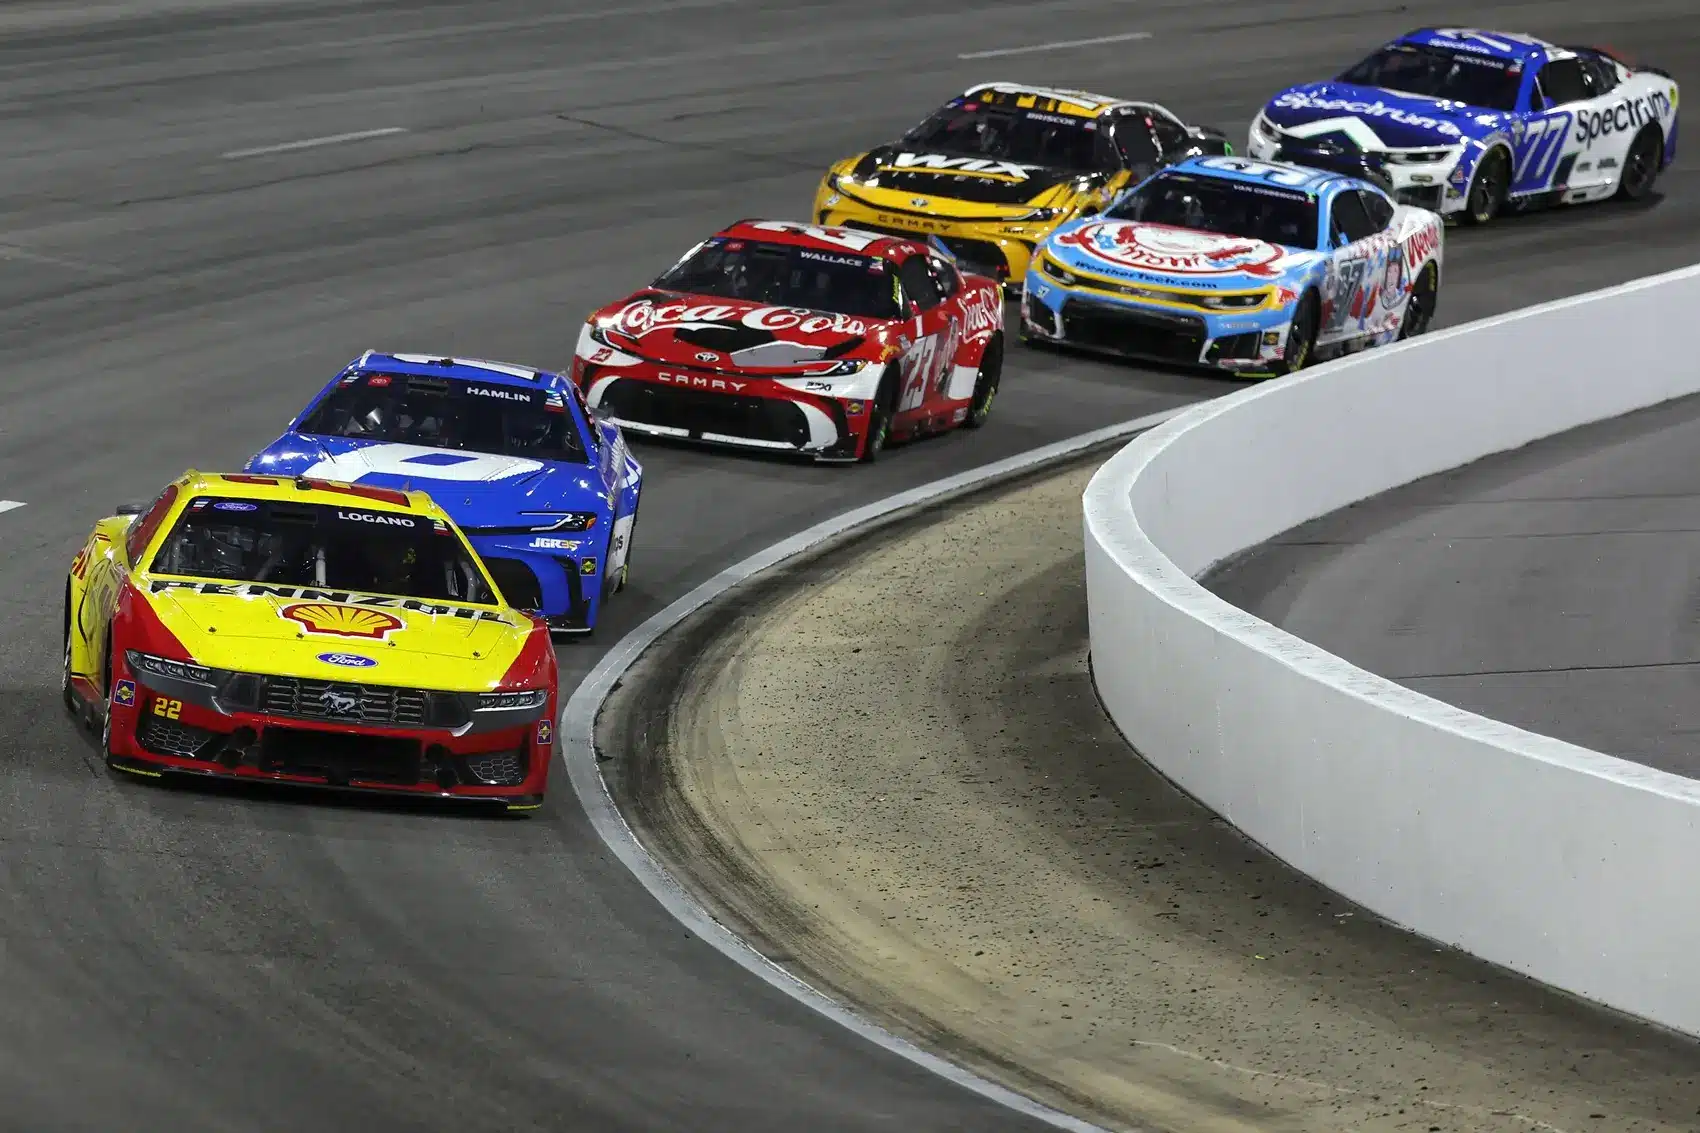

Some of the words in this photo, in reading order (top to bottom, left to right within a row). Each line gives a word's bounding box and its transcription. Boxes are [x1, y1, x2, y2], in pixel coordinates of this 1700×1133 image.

[1273, 90, 1464, 138] Spectrum
[1575, 90, 1671, 150] Spectrum
[1514, 114, 1569, 184] 77
[893, 152, 1046, 181] WIX
[877, 213, 951, 232] CAMRY
[800, 251, 863, 268] WALLACE
[606, 296, 868, 338] Coca-Cola
[658, 371, 748, 392] CAMRY
[466, 386, 532, 403] HAMLIN
[338, 511, 416, 528] LOGANO
[153, 697, 183, 720] 22
